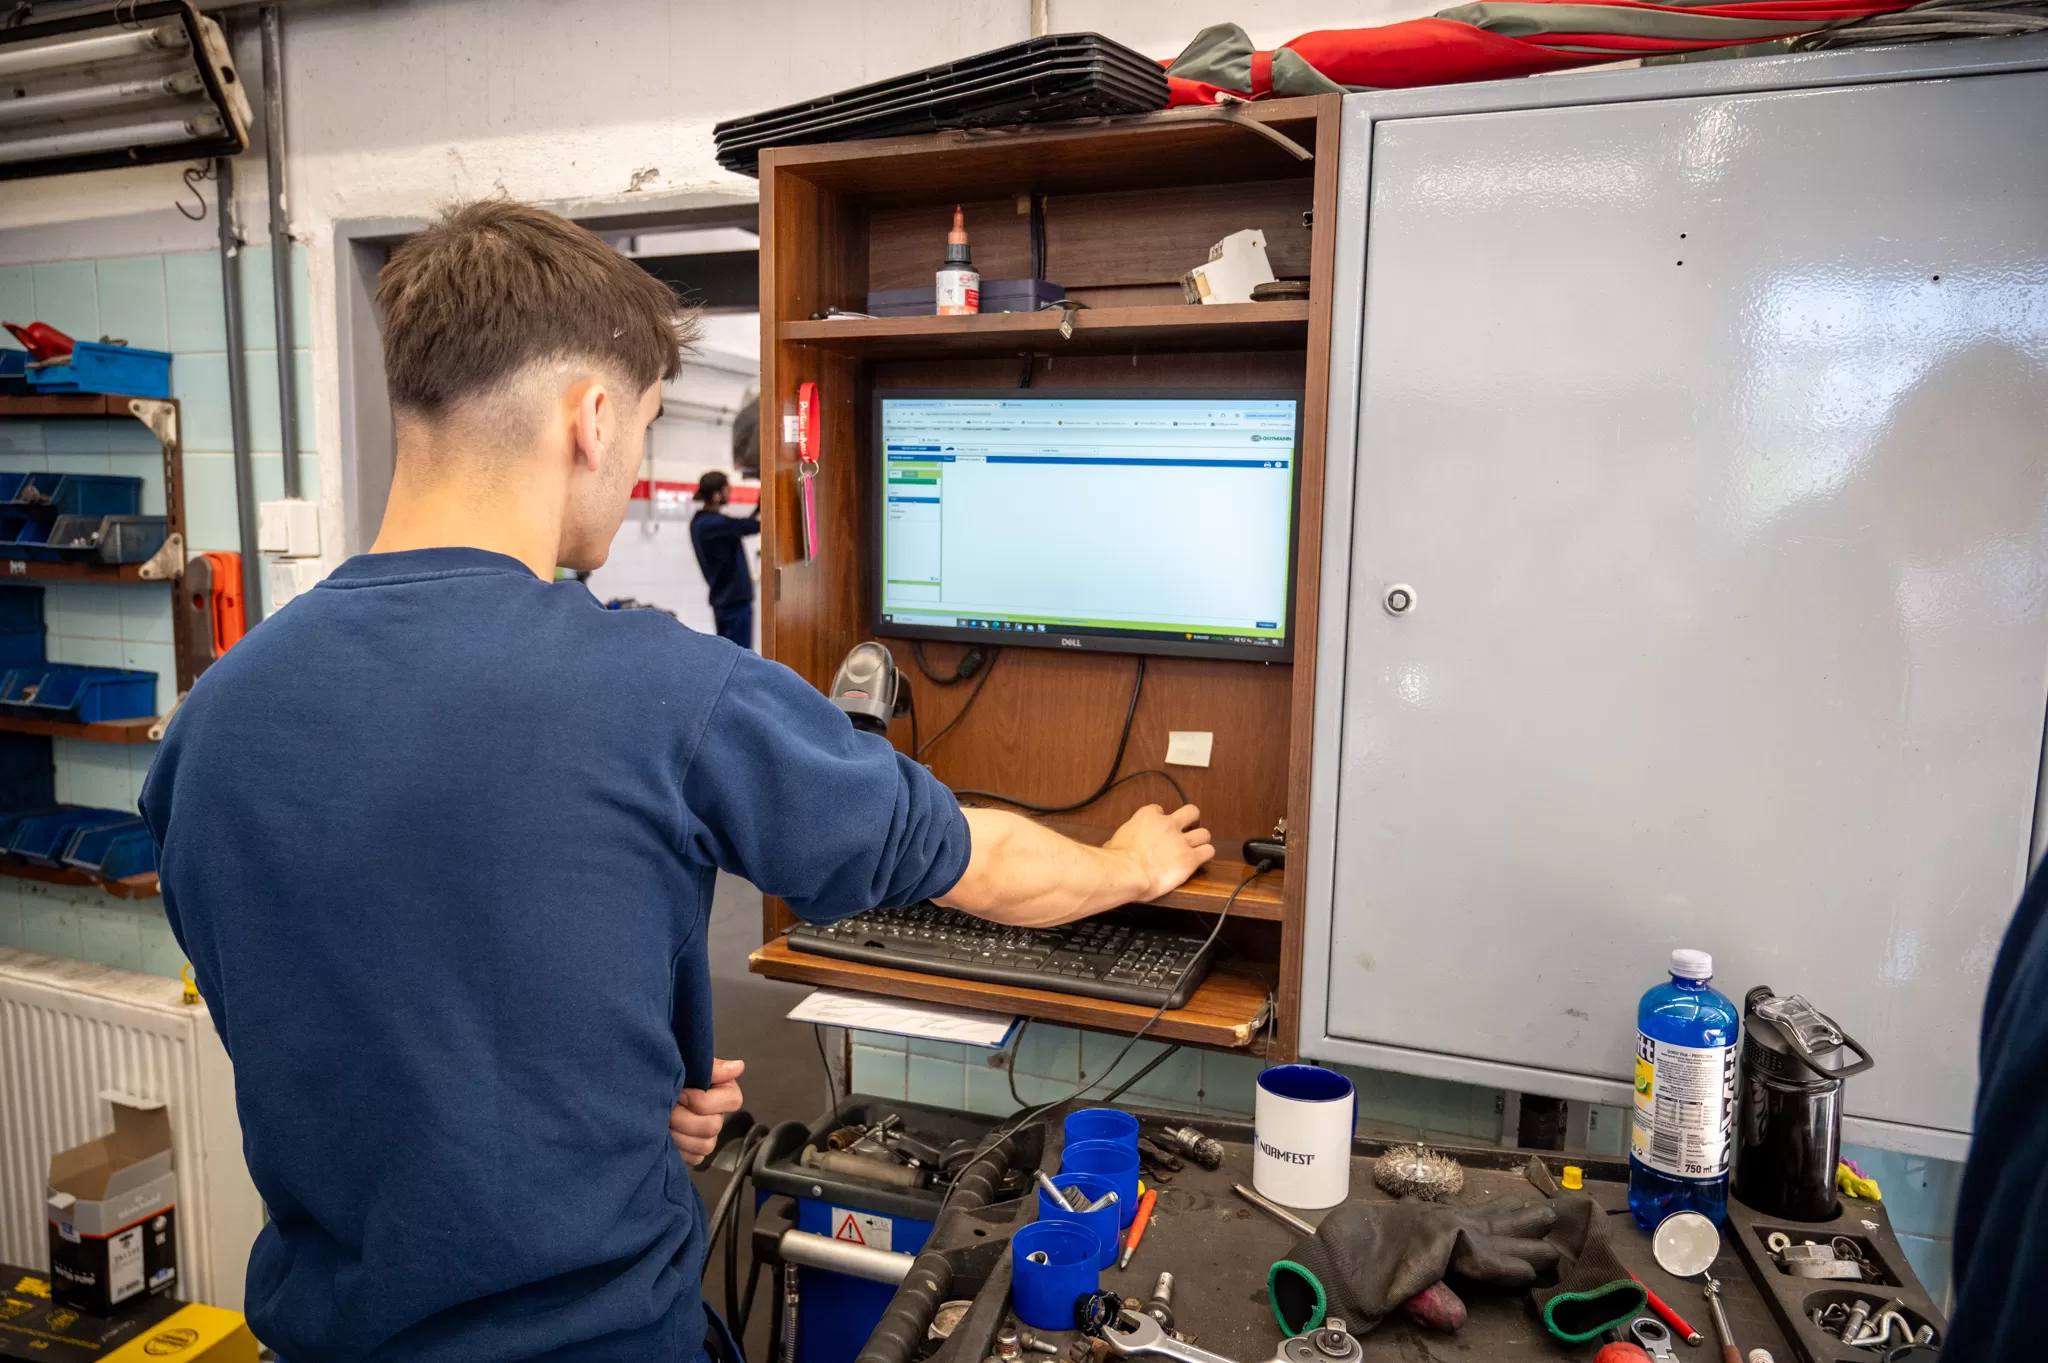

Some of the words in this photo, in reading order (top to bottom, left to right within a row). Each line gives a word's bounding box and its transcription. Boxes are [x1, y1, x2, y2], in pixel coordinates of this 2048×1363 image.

[1061, 638, 1082, 647] DELL
[1685, 1164, 1702, 1173] 750
[1703, 1165, 1712, 1173] ml
